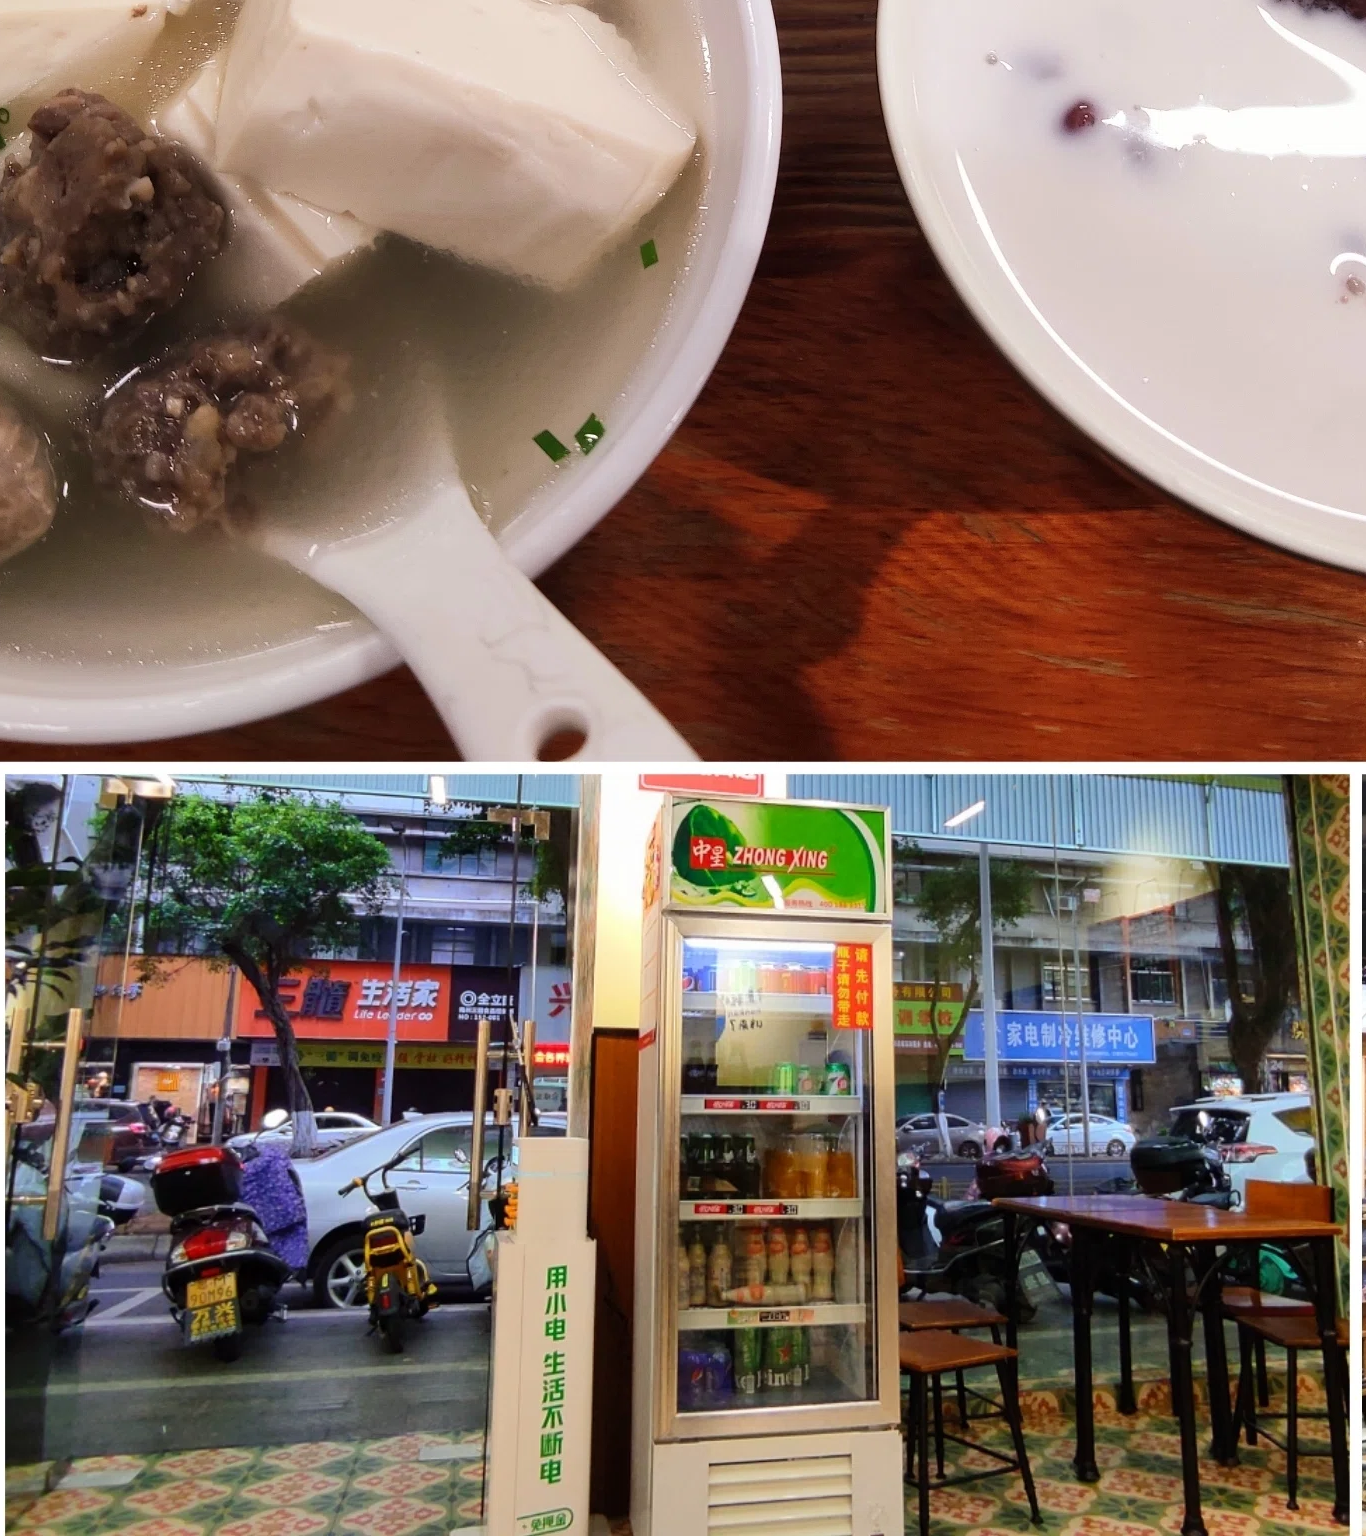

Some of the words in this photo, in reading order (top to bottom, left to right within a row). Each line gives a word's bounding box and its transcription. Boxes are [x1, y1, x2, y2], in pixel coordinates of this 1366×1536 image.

[692, 838, 726, 869] 中星
[733, 846, 787, 867] ZHONG
[788, 845, 829, 874] XING
[356, 978, 441, 1008] 生活家
[836, 945, 851, 1027] 瓶子请勿带走
[854, 947, 870, 1027] 请先付款
[354, 1009, 375, 1021] Life
[1007, 1021, 1139, 1049] 家电制冷维修中心
